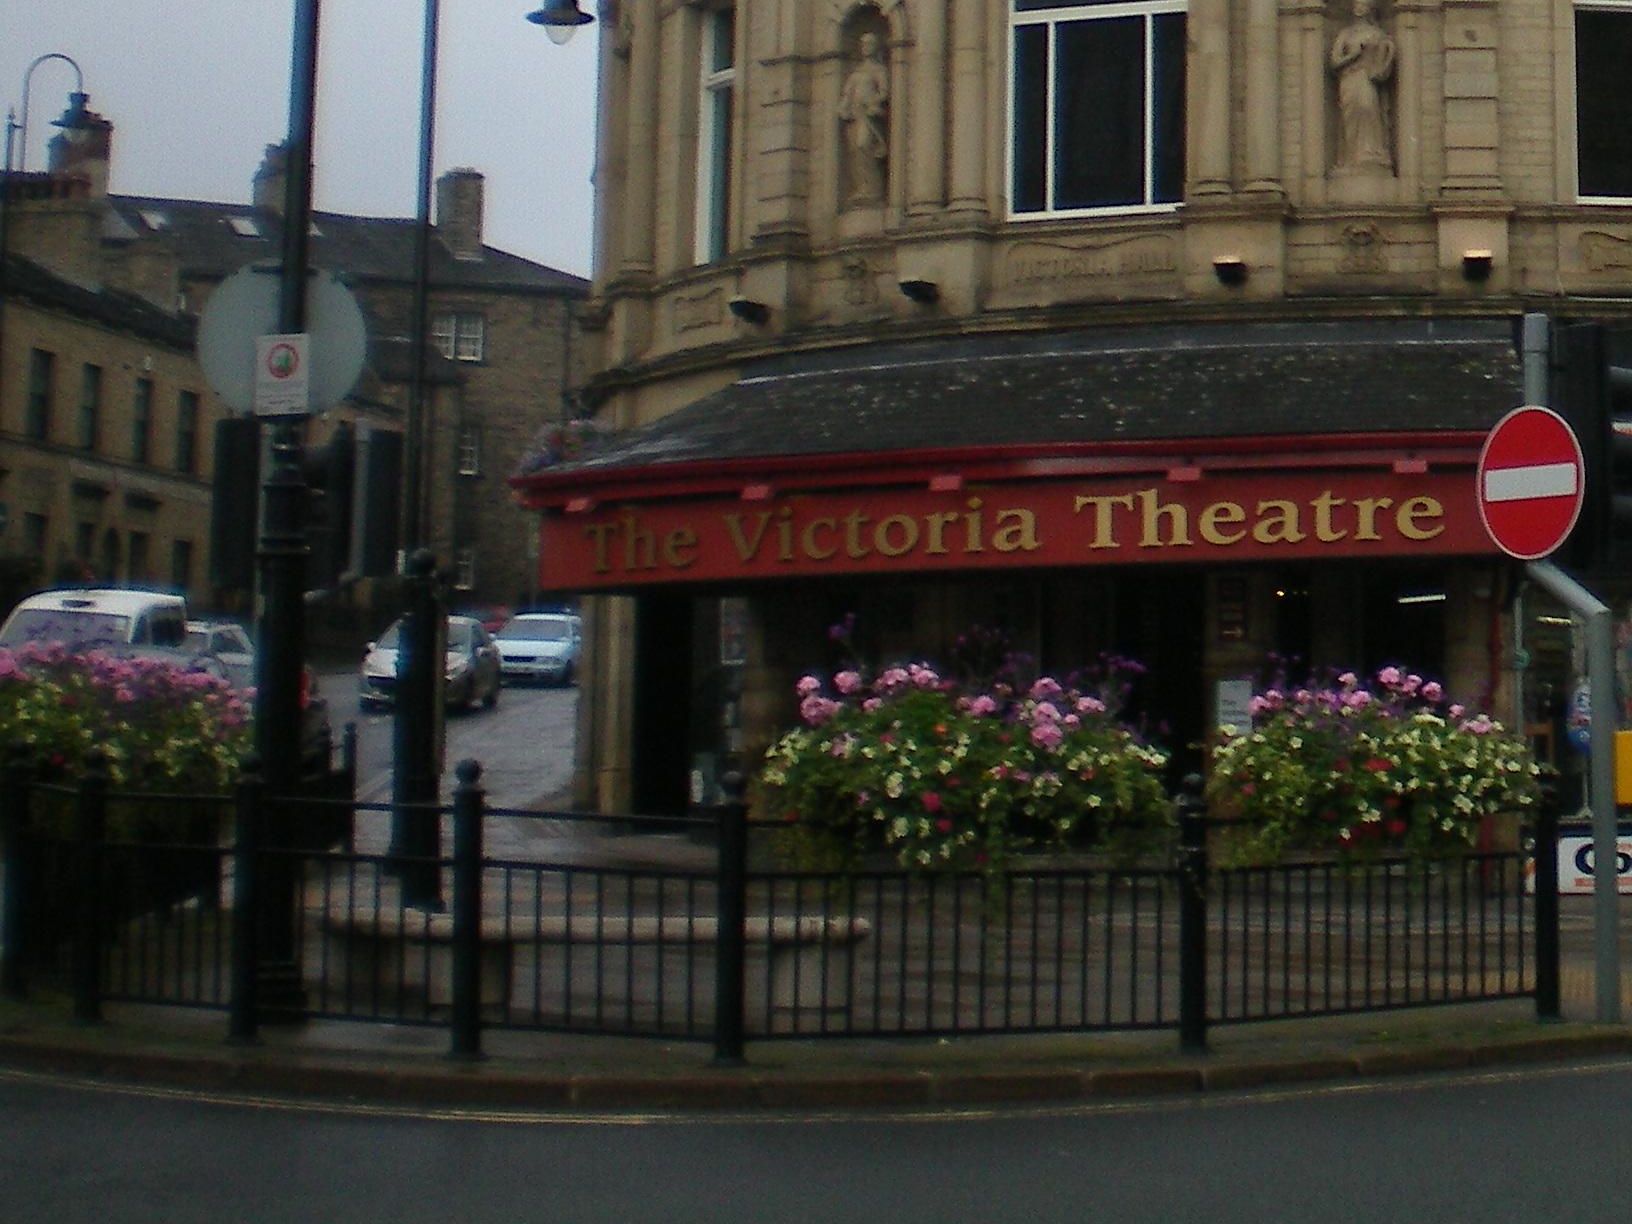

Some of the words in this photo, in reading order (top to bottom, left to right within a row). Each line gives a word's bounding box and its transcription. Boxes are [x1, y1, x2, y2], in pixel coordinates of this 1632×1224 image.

[584, 506, 698, 574] The
[723, 496, 1041, 562] Victoria
[1074, 487, 1446, 549] Theatre
